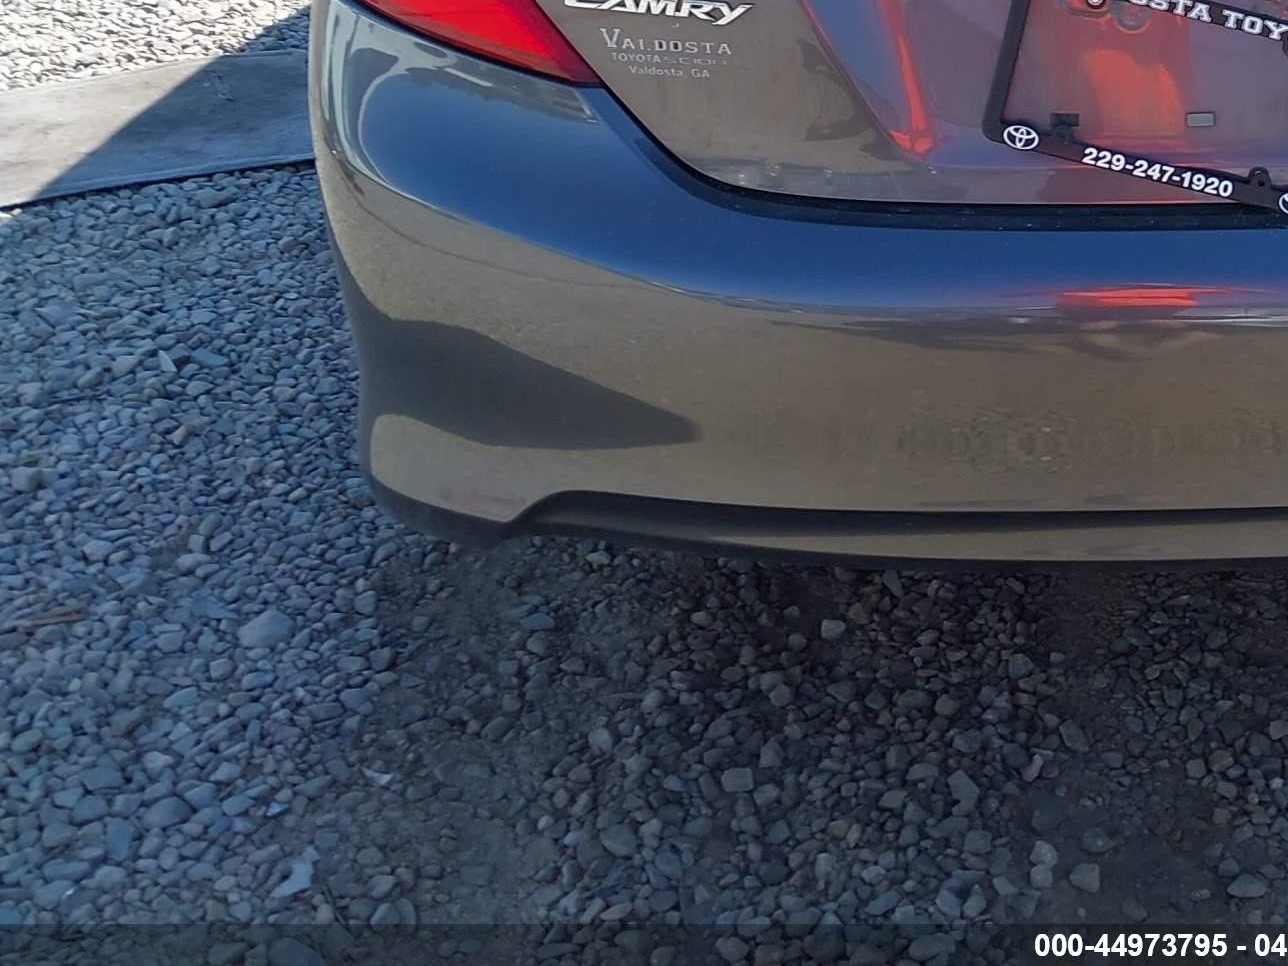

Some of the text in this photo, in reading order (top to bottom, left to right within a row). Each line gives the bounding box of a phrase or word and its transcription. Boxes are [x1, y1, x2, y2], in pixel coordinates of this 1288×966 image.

[610, 52, 660, 63] TOYOTA
[690, 68, 711, 79] GA
[1082, 147, 1233, 199] 229-247-1920
